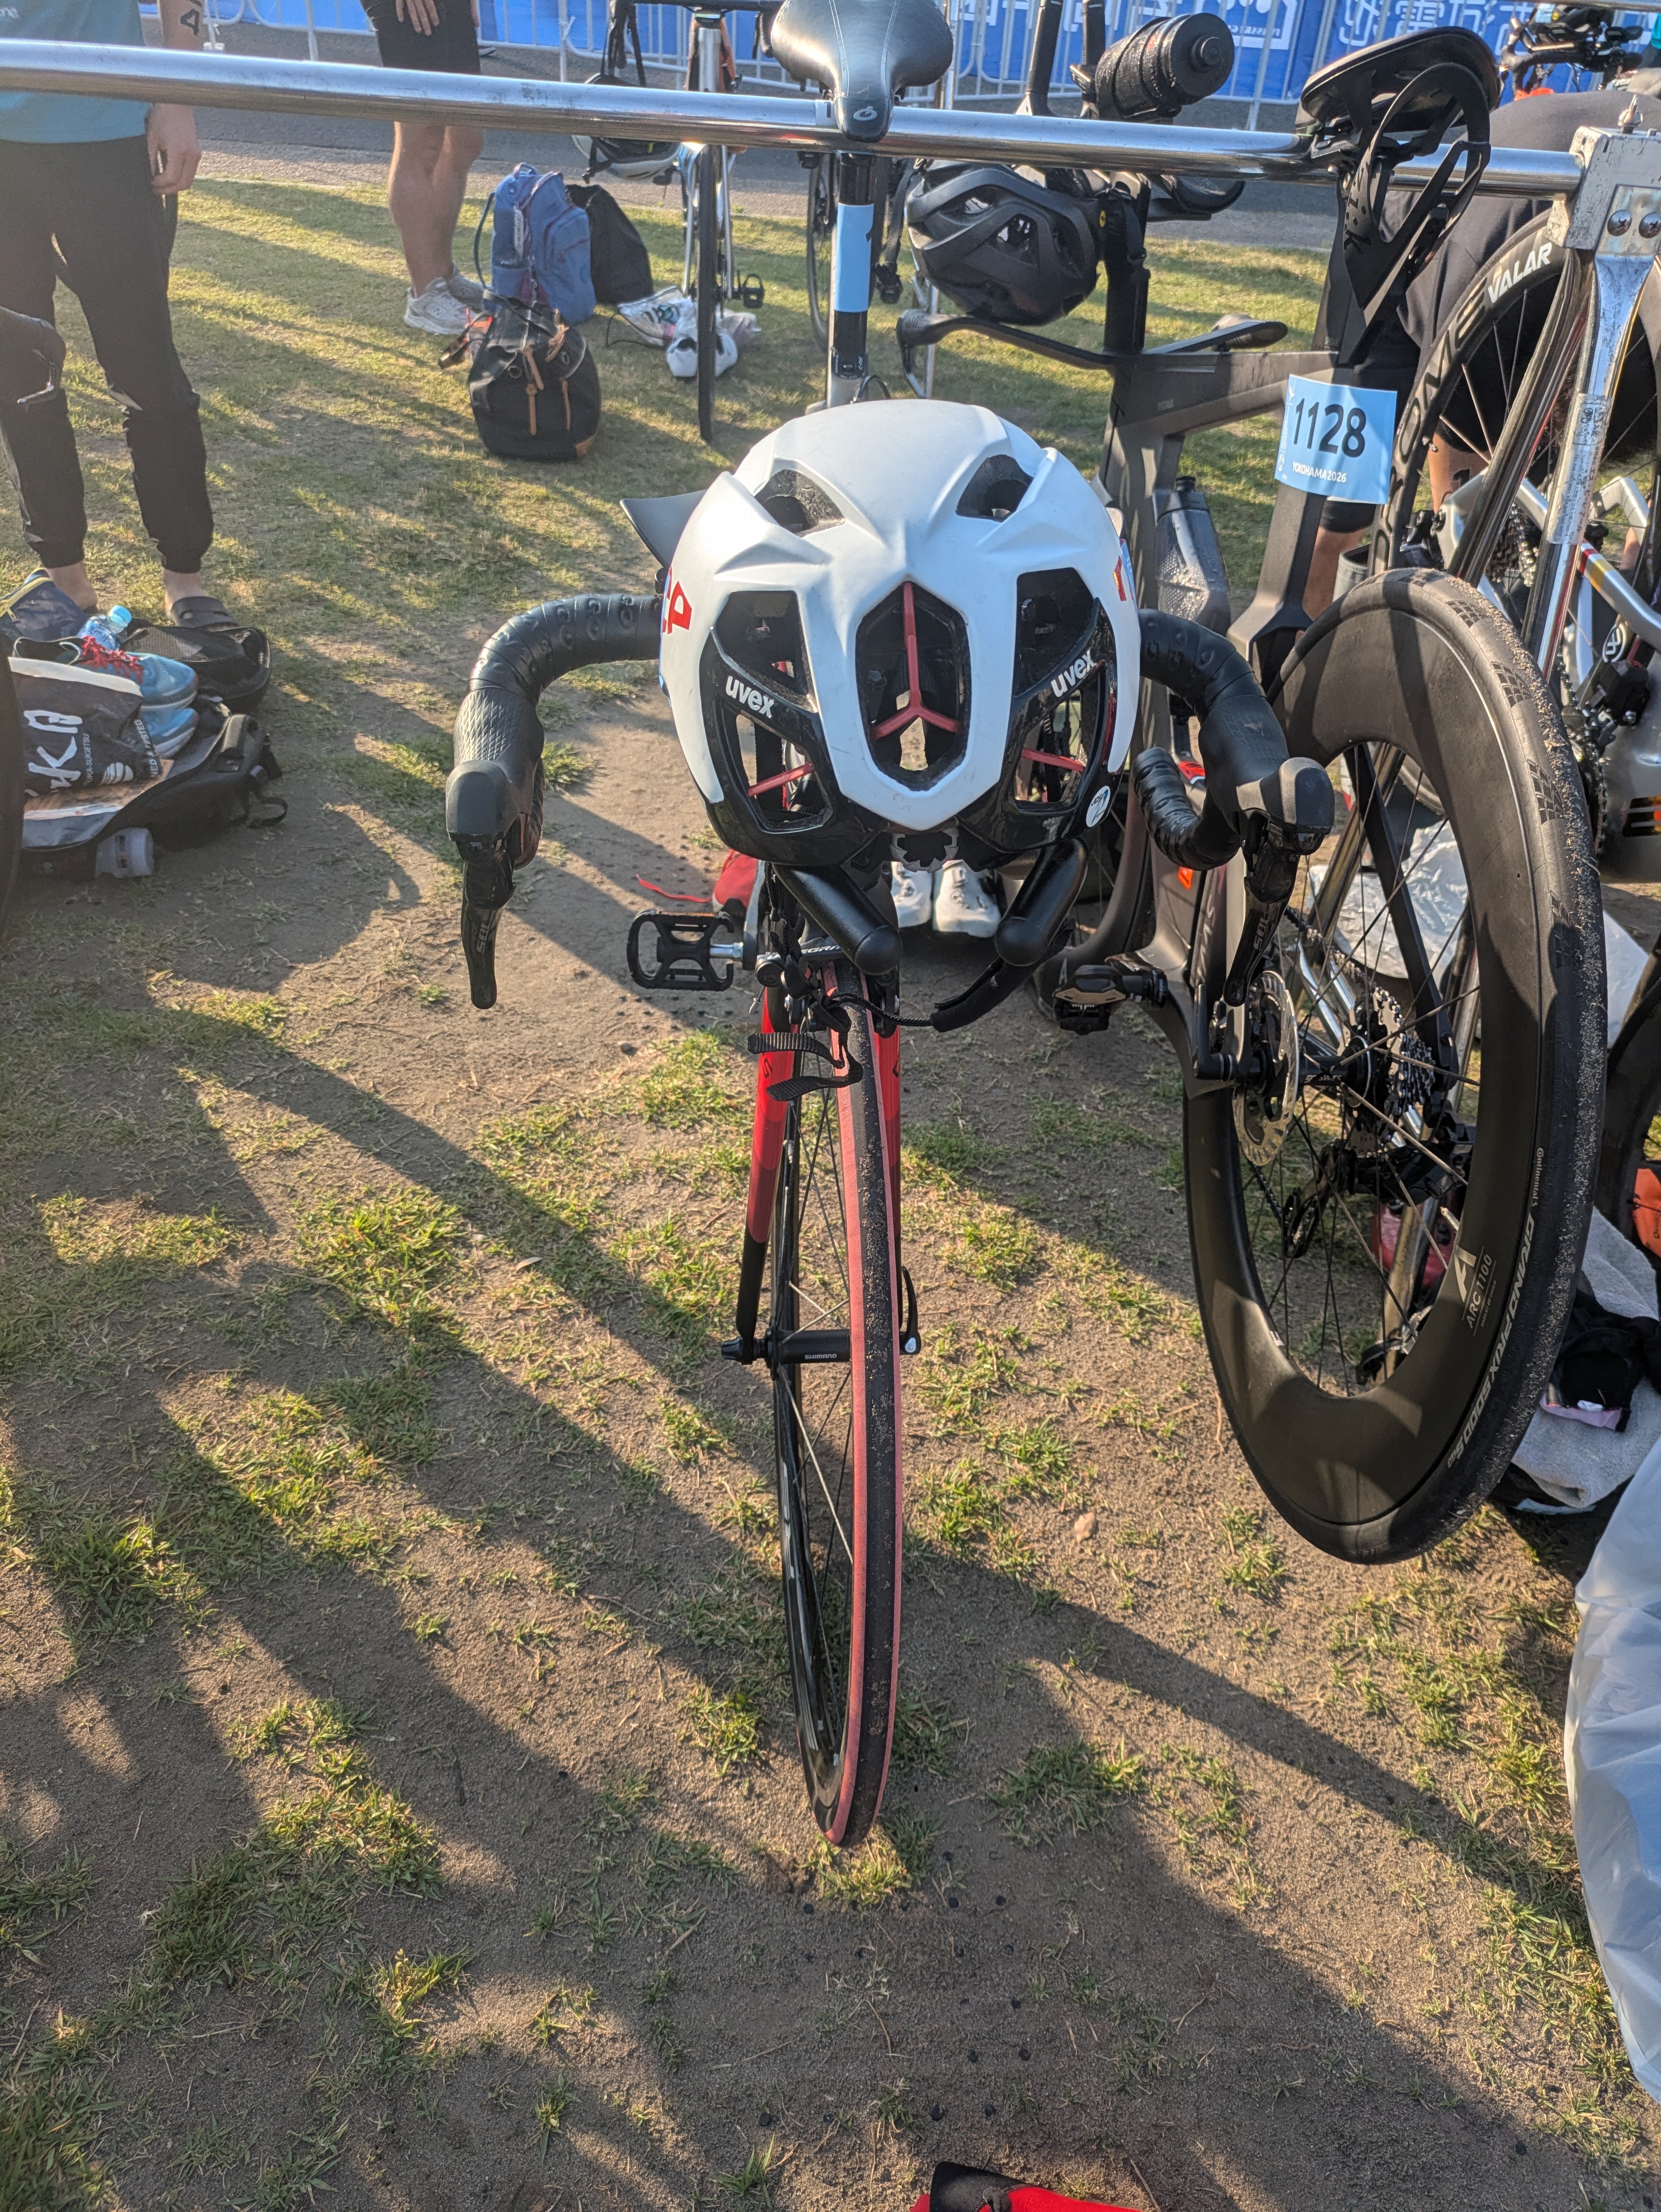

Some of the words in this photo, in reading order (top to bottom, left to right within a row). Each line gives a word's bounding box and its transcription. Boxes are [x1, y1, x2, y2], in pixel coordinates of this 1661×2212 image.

[1488, 242, 1552, 303] VALAR
[1293, 398, 1366, 458] 1128
[1292, 461, 1327, 480] YOKOHAMA
[1327, 471, 1347, 483] 2026
[726, 675, 775, 719] uvex
[1051, 647, 1096, 697] uvex
[1254, 918, 1268, 951] 105
[1532, 1147, 1544, 1199] Continental
[1466, 1291, 1481, 1329] ARC
[1476, 1254, 1492, 1290] 1100
[1509, 1213, 1535, 1319] GRAND
[1489, 1314, 1514, 1382] PRIX
[1463, 1377, 1491, 1446] 5000
